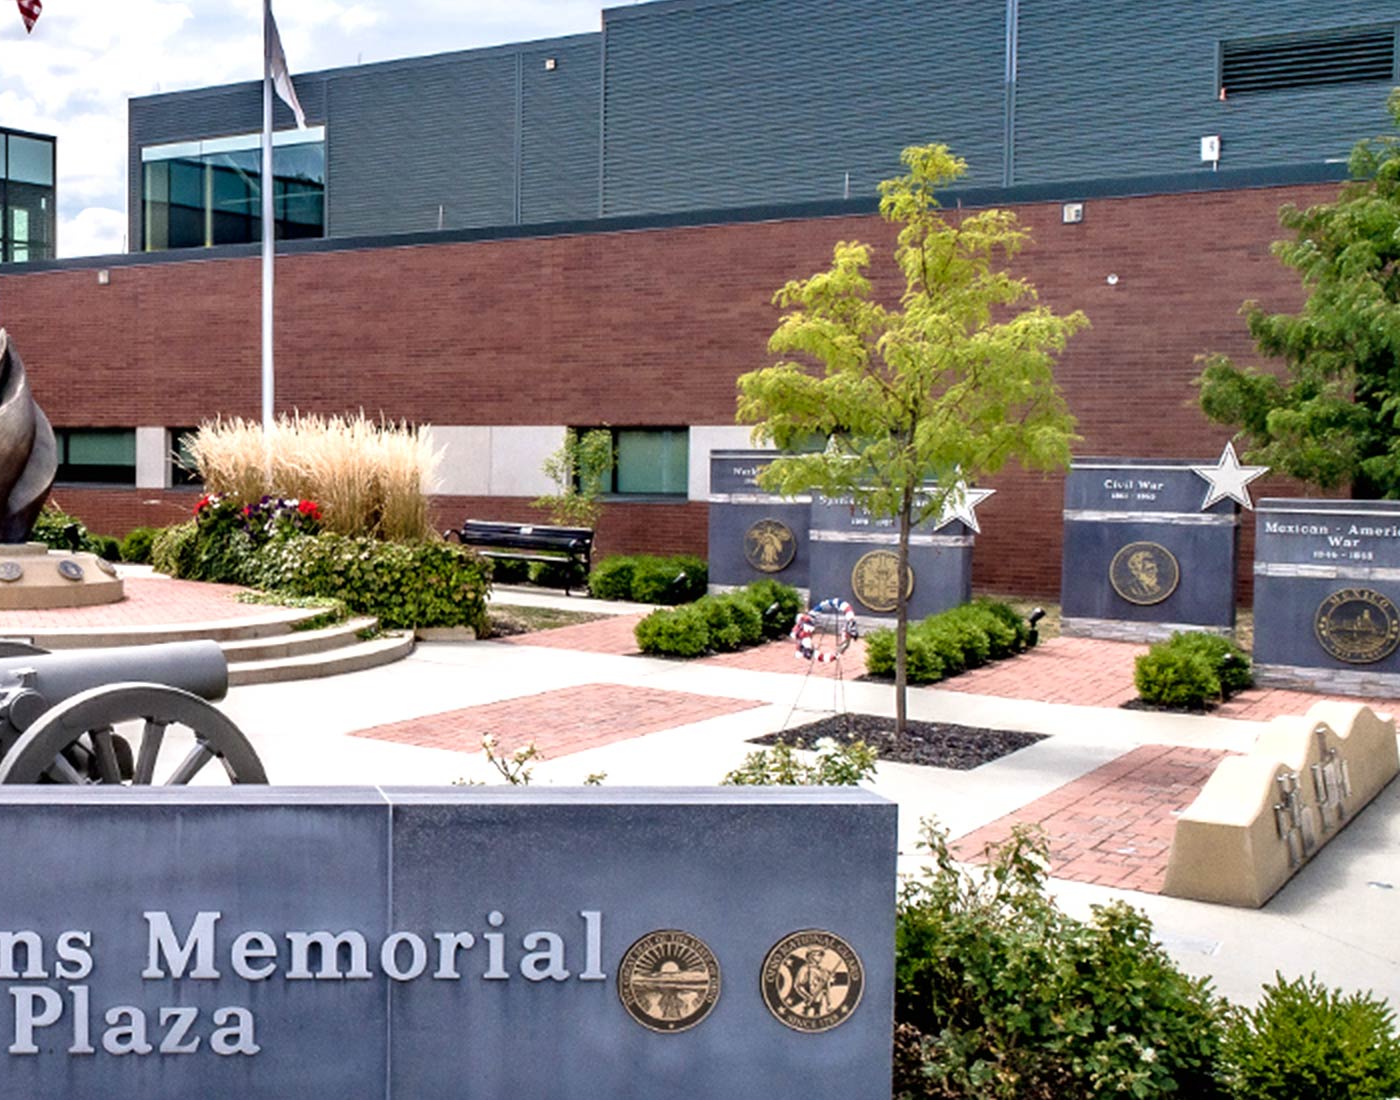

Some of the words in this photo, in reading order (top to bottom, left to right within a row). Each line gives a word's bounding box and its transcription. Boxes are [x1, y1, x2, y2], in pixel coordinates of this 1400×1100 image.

[1103, 479, 1134, 489] Civil
[1137, 480, 1165, 490] War
[1264, 522, 1329, 535] Mexican
[1327, 536, 1360, 547] War
[1329, 590, 1390, 608] MEXICO
[141, 910, 608, 981] Memorial
[780, 935, 836, 956] NATIONAL
[836, 945, 860, 981] GUARD
[9, 986, 260, 1055] Plaza
[785, 1014, 817, 1029] SINCE
